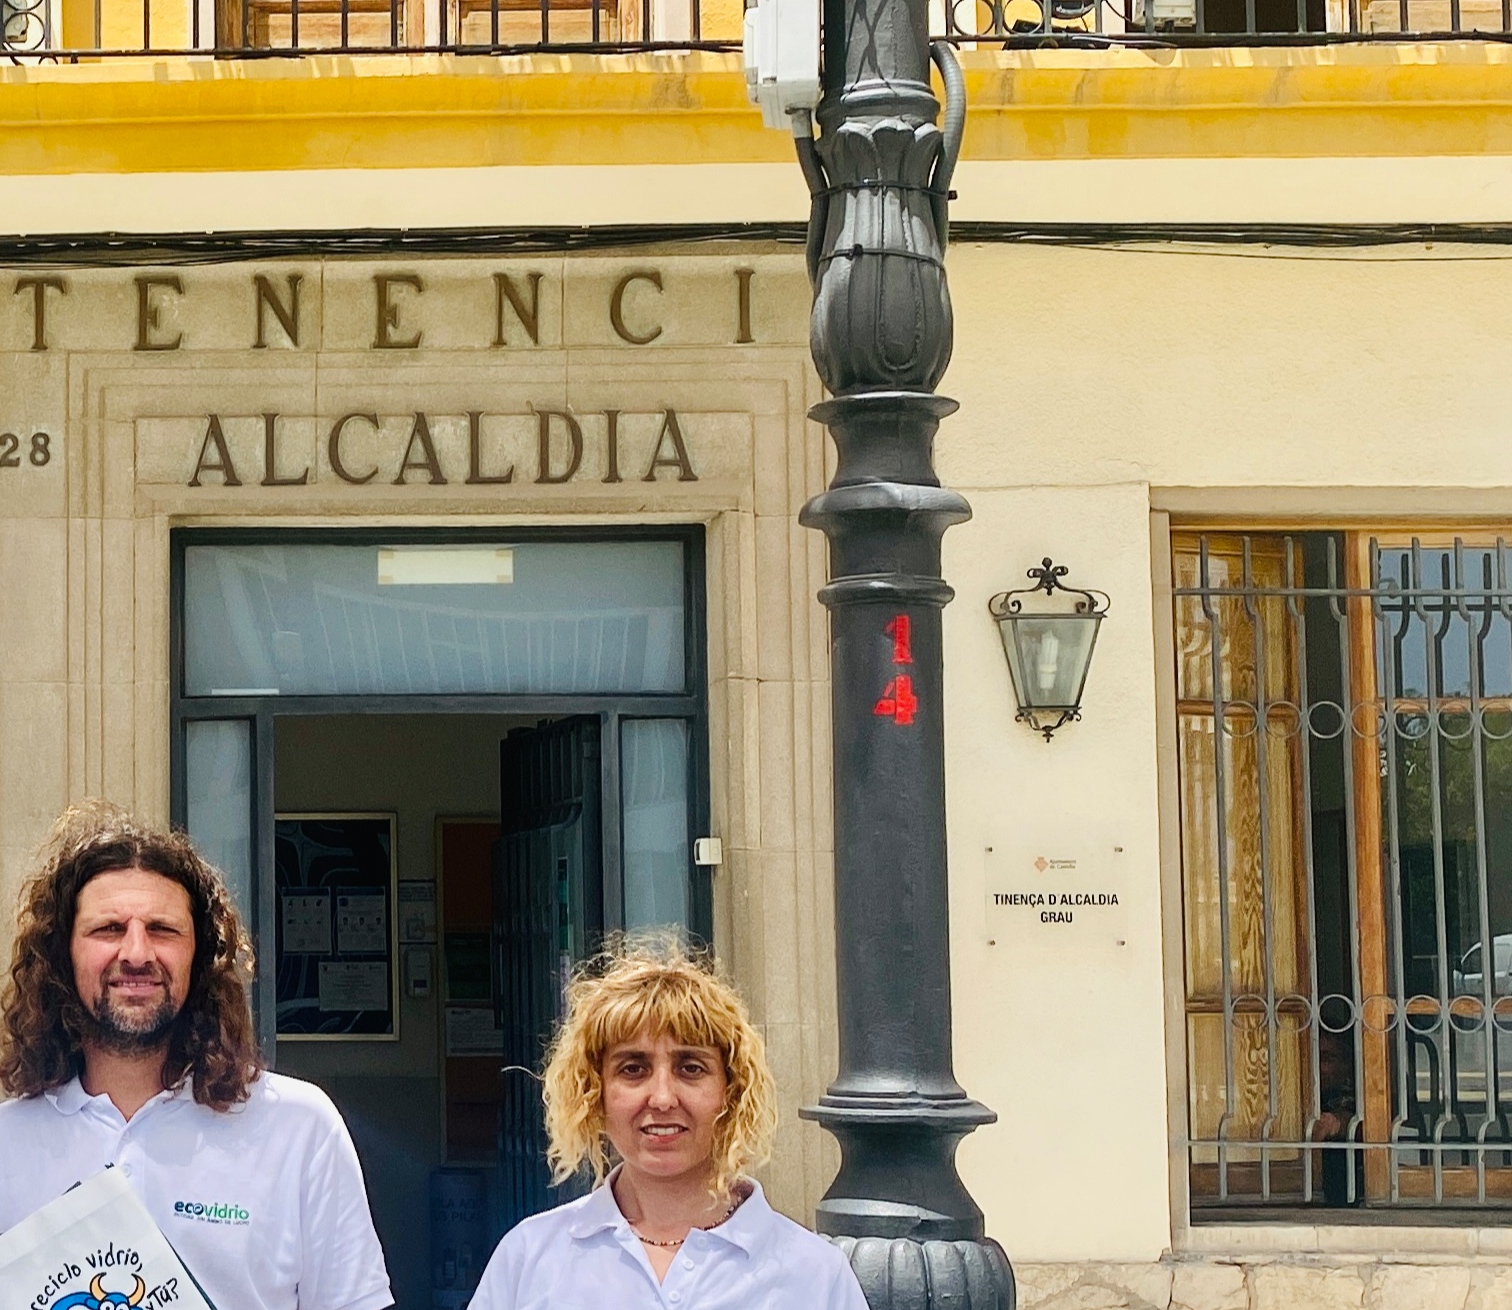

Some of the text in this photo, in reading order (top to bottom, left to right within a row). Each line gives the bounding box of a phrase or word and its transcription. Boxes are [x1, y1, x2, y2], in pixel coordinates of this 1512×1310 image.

[13, 269, 756, 351] TENENCI
[187, 408, 699, 487] ALCALDIA
[993, 893, 1045, 908] TINENÇA
[1040, 911, 1073, 923] GRAU
[174, 1201, 250, 1220] ecovidrio
